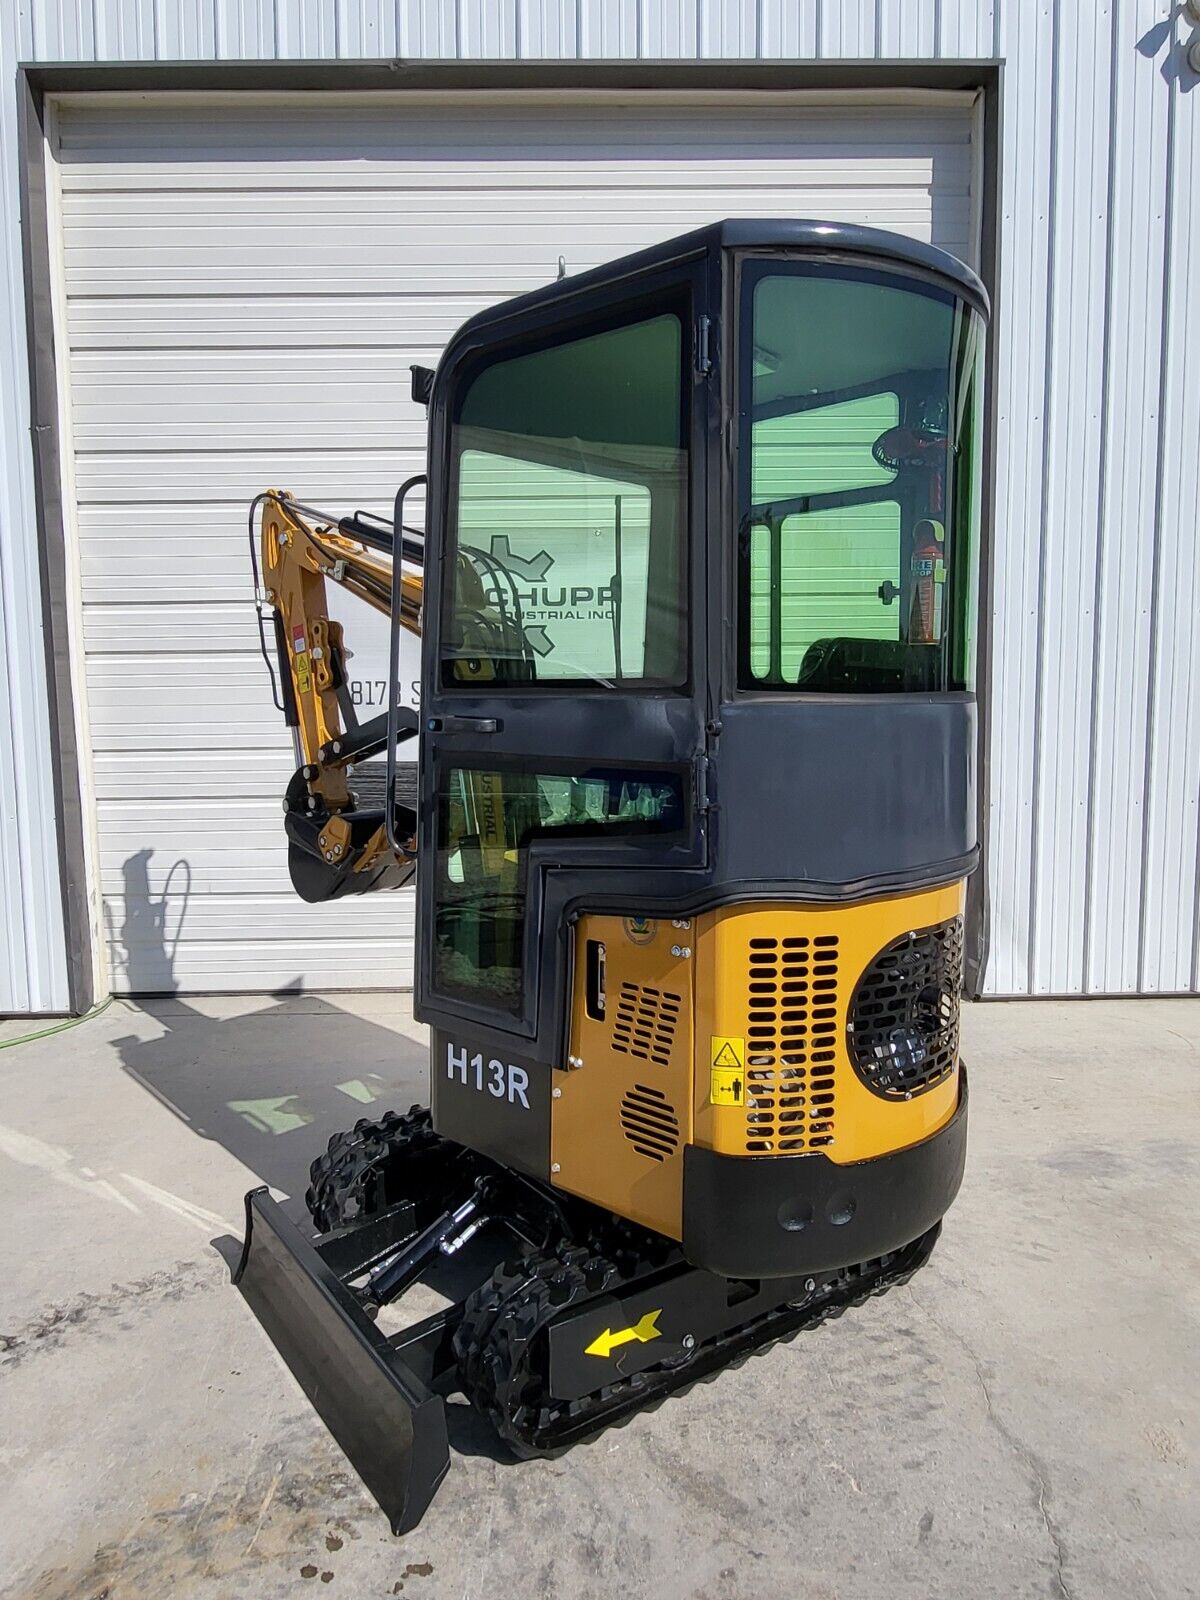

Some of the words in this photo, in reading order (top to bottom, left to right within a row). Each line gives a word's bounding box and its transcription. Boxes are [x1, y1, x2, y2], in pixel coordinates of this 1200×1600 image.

[485, 587, 615, 606] CHUPP
[351, 681, 401, 705] 817
[447, 1042, 531, 1110] H13R
